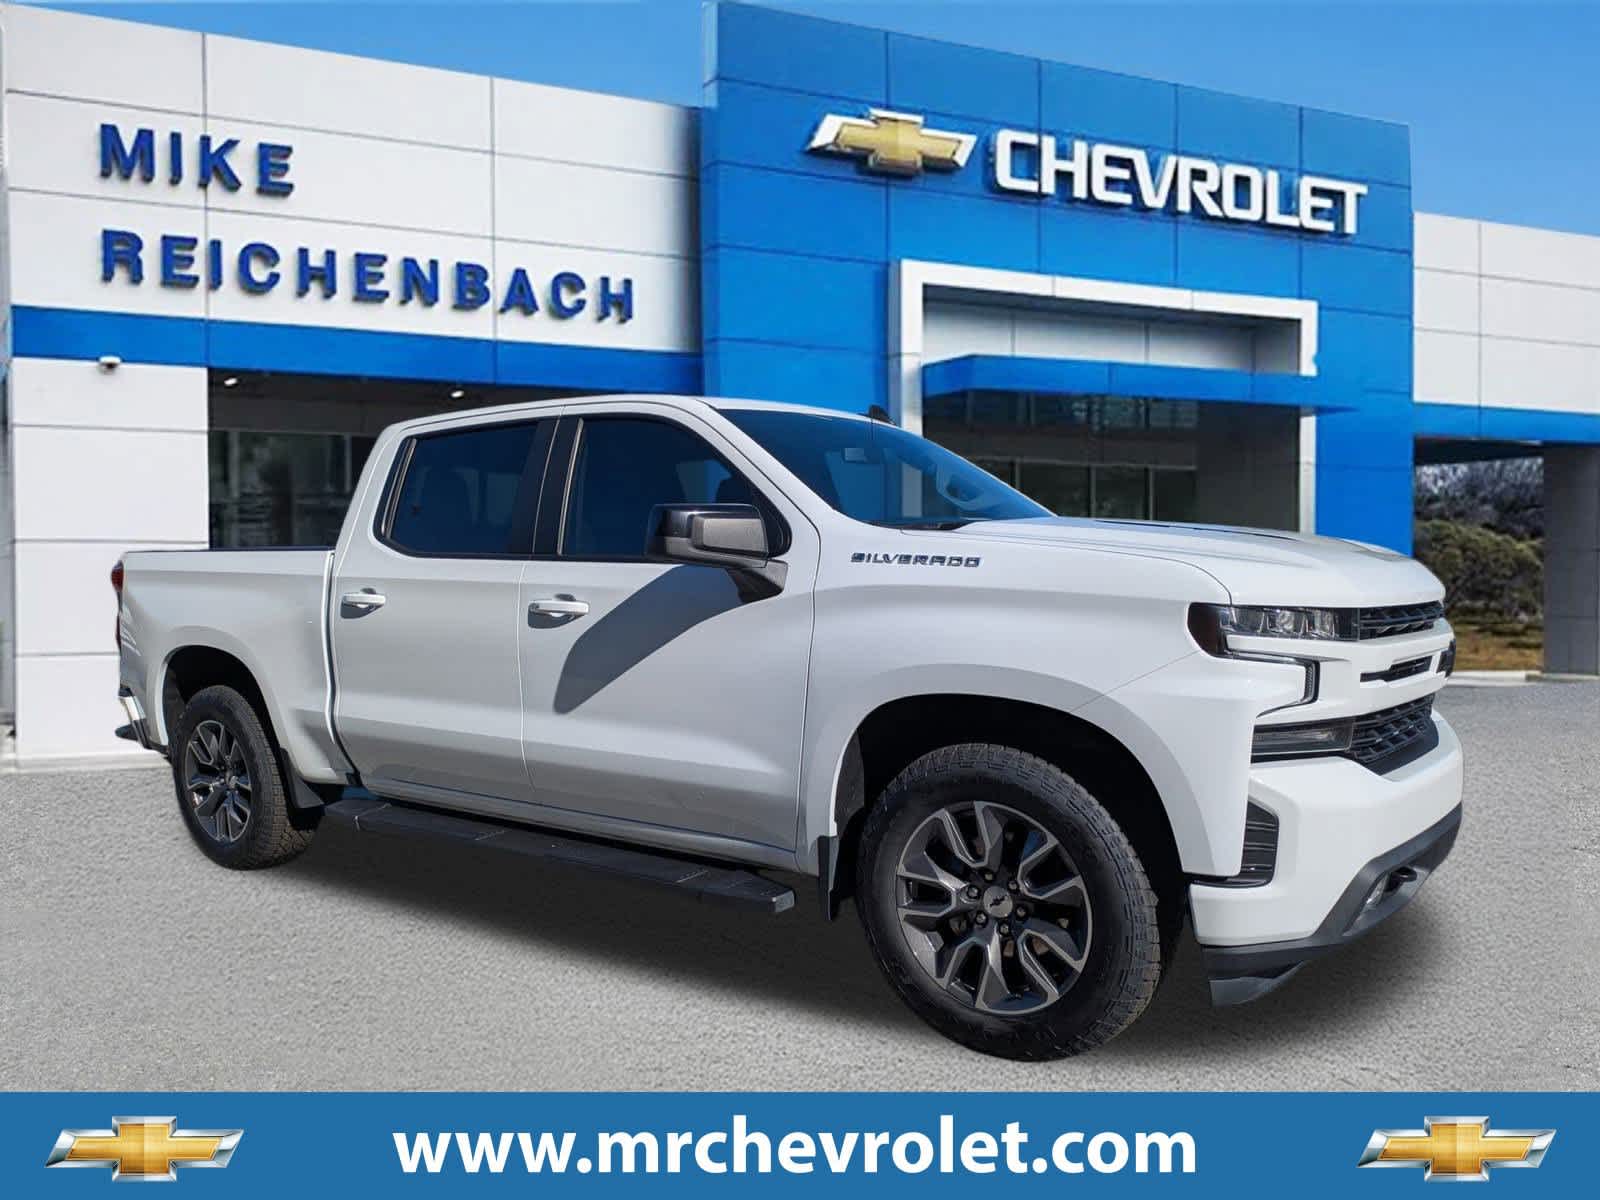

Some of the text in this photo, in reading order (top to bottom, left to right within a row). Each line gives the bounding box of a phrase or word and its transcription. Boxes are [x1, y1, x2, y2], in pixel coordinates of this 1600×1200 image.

[100, 123, 294, 197] MIKE
[994, 128, 1369, 235] CHEVROLET
[101, 229, 634, 323] REICHENBACH
[850, 552, 982, 568] SILVERADO
